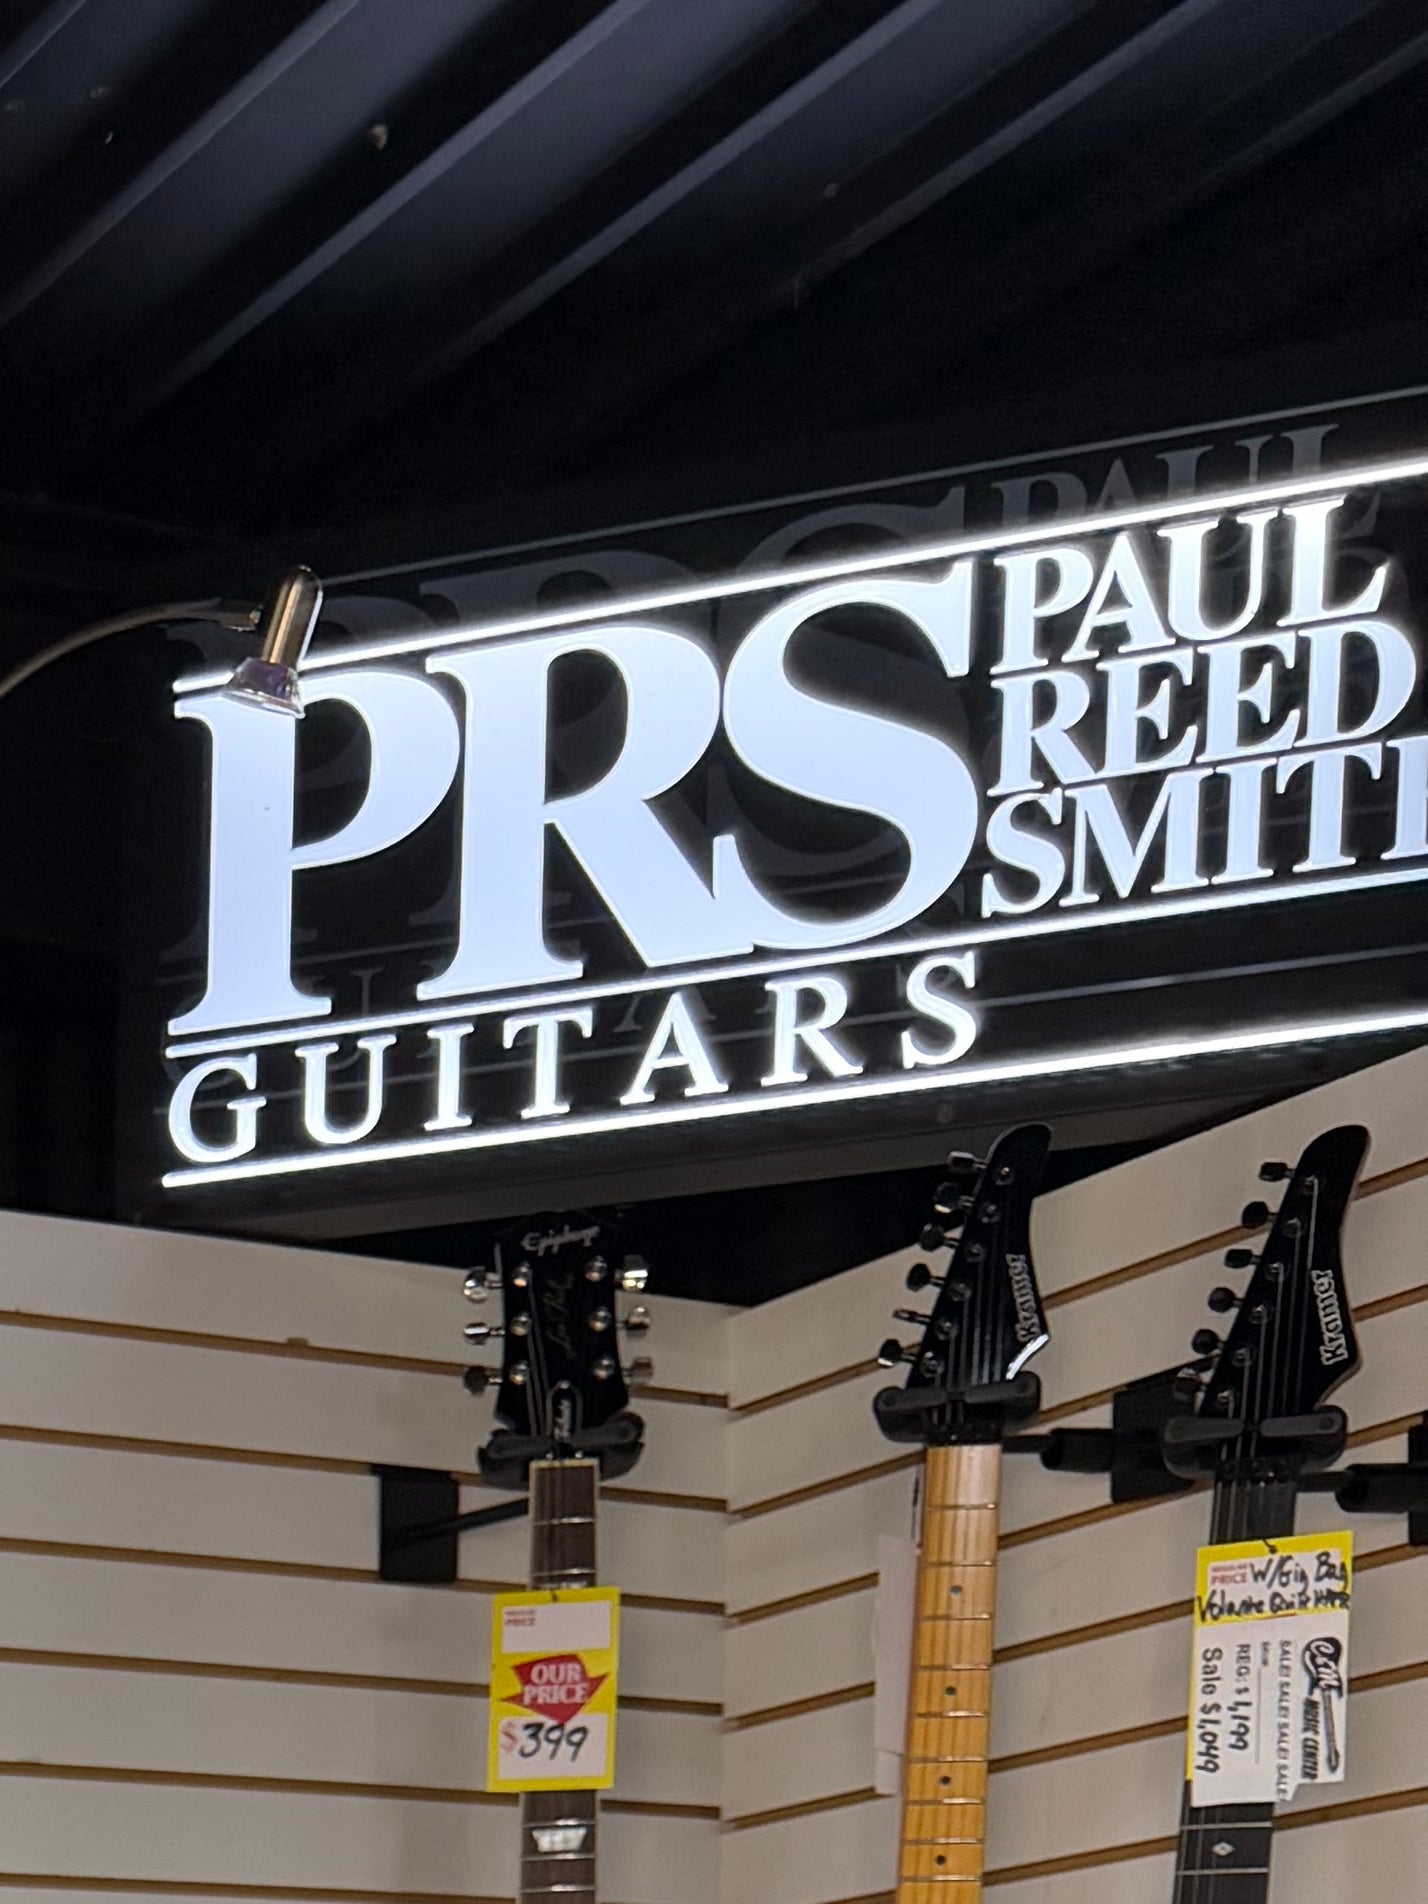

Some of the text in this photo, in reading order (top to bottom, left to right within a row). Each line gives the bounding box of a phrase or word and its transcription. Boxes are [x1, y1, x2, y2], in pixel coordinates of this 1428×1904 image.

[989, 493, 1392, 675] PAUL
[987, 619, 1417, 797] REED
[167, 560, 979, 1036] PRS
[167, 952, 978, 1164] GUITARS
[1005, 1253, 1042, 1342] Kramer
[1311, 1269, 1349, 1366] Kramer
[522, 1684, 588, 1705] PRICE
[530, 1663, 582, 1685] OUR
[501, 1720, 588, 1763] $399
[1195, 1702, 1222, 1773] $1,049
[1301, 1698, 1320, 1780] MUSIC CENTER
